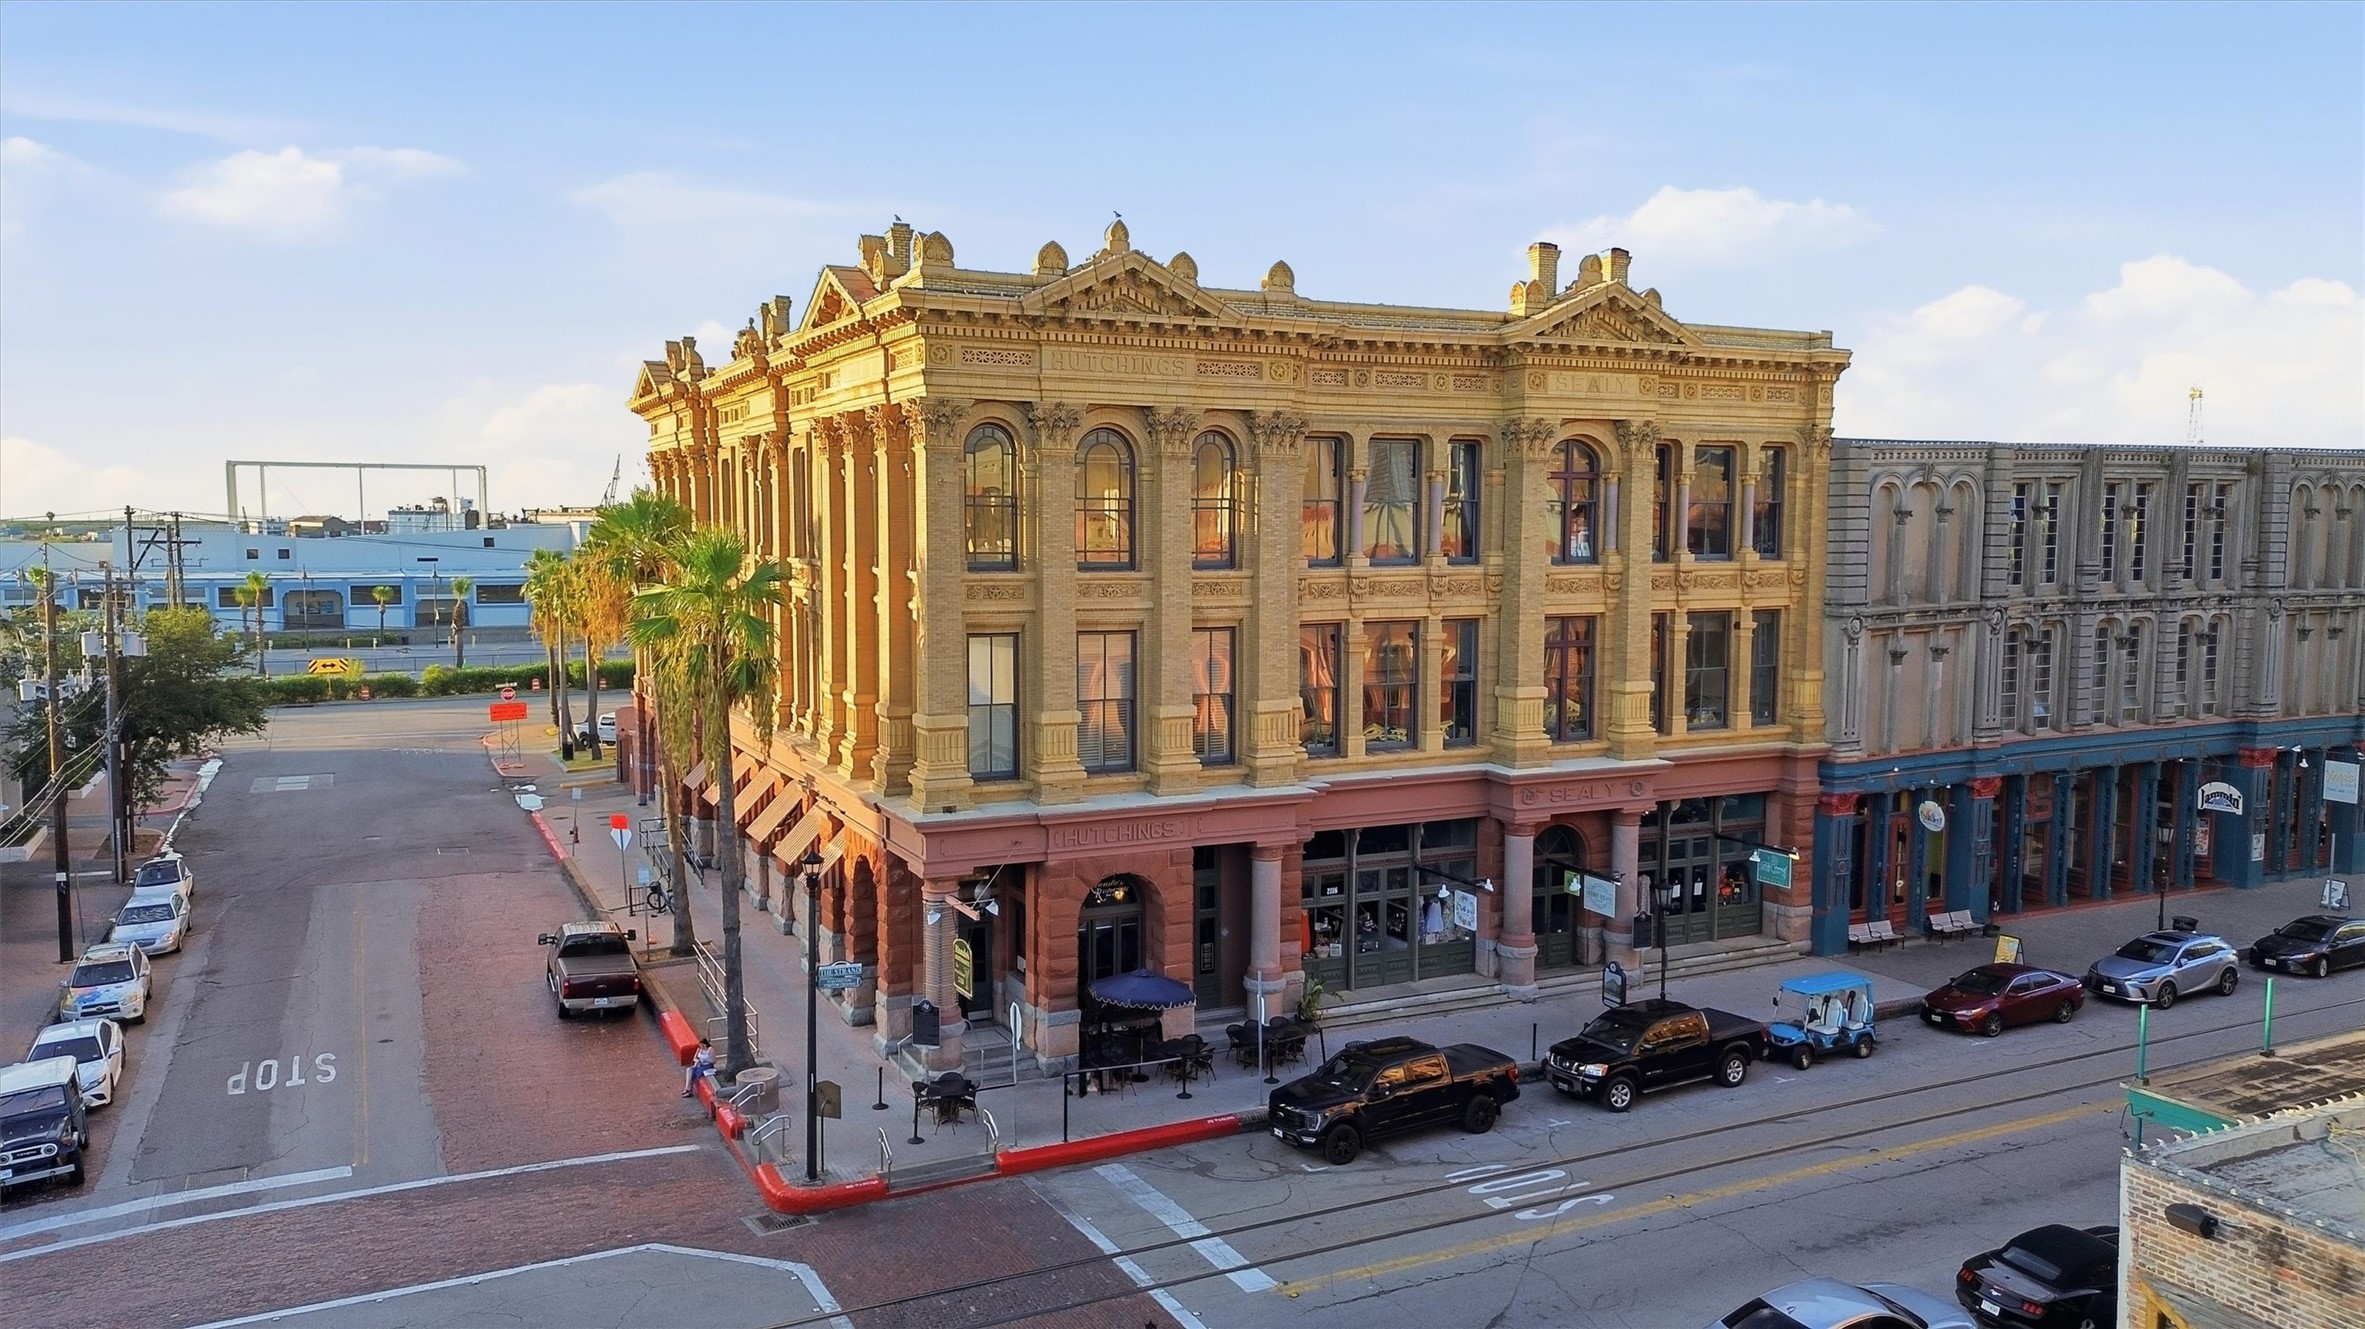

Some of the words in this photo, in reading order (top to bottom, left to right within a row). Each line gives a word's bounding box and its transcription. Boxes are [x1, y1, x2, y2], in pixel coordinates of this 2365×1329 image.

[1051, 351, 1185, 376] HUTCHINGS
[1556, 374, 1627, 394] SEALY
[1550, 783, 1615, 802] SEALY
[1063, 822, 1176, 848] HUTCHINGS
[820, 969, 831, 977] THE
[833, 966, 862, 976] STRAND
[227, 1053, 337, 1095] STOP
[1445, 1164, 1615, 1220] STOP
